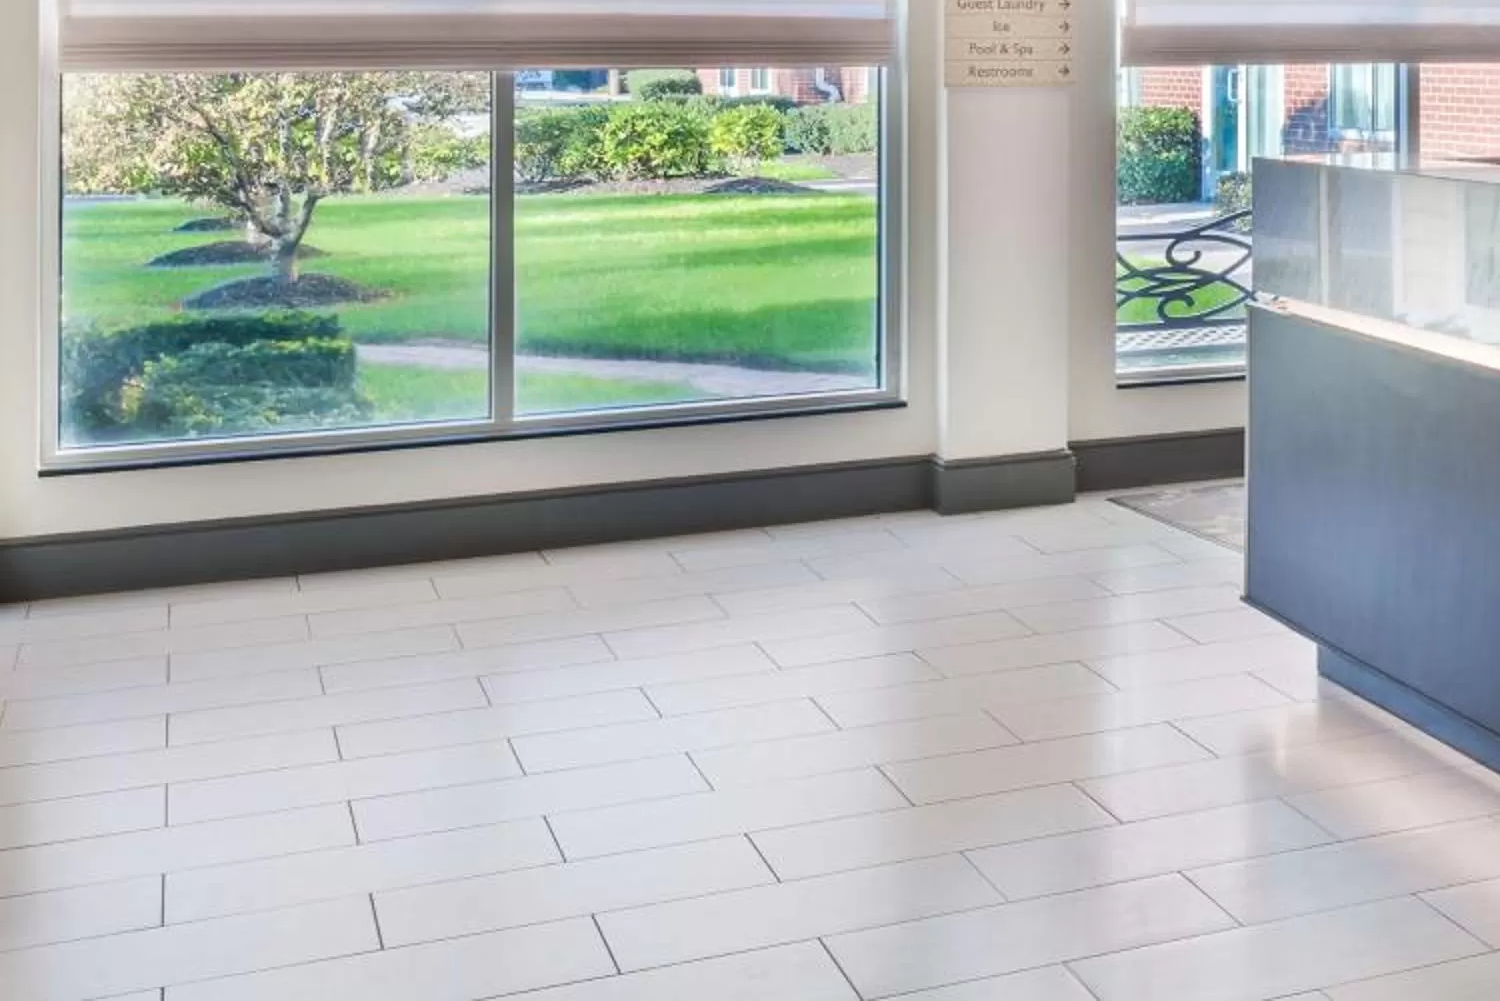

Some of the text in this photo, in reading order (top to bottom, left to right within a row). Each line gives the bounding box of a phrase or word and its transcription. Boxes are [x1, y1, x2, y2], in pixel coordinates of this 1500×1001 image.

[992, 20, 1011, 32] Ice
[969, 42, 1033, 56] Pool & Spa
[968, 65, 1034, 79] Restrooms
